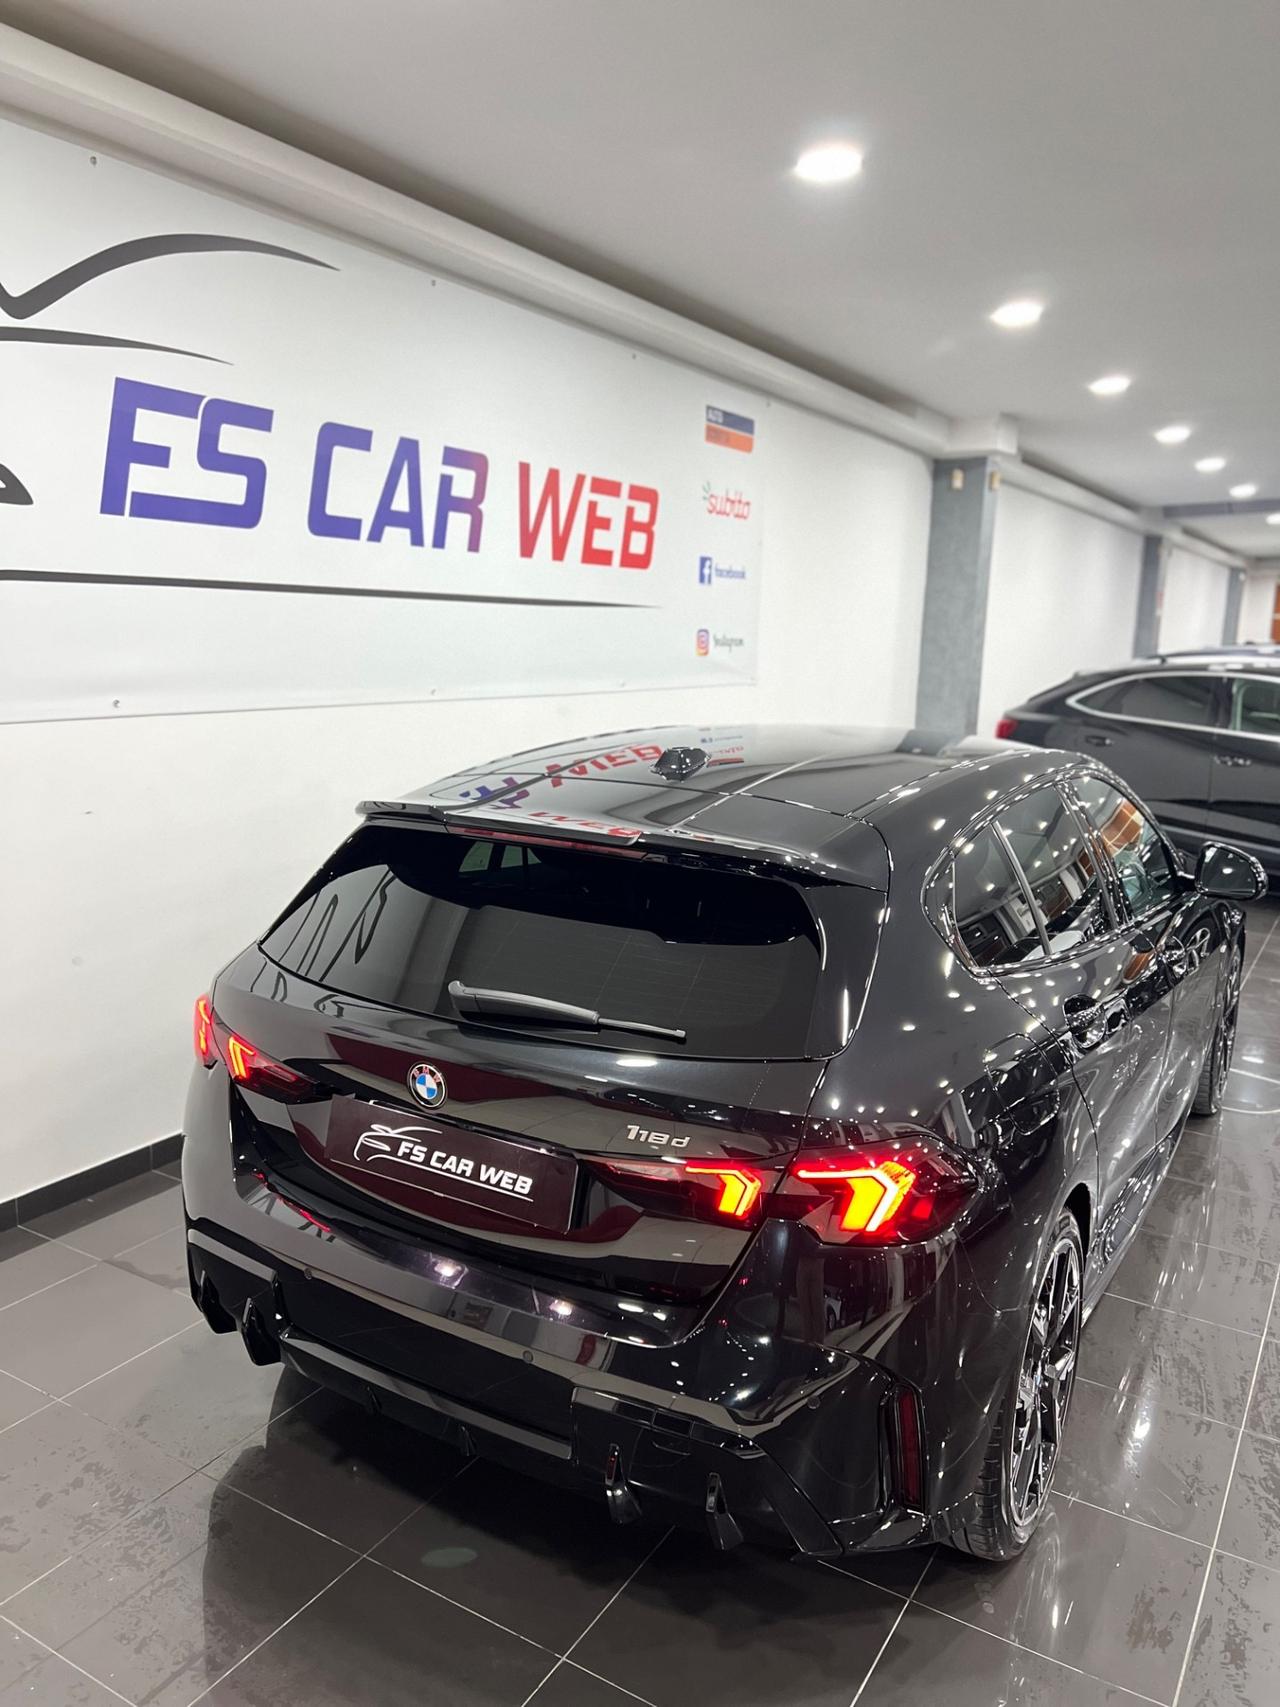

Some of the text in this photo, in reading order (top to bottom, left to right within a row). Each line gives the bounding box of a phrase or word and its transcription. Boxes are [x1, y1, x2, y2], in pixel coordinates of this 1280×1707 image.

[100, 377, 660, 570] FS CAR WEB
[412, 1065, 442, 1083] BMW
[397, 1141, 533, 1195] FS CAR WEB
